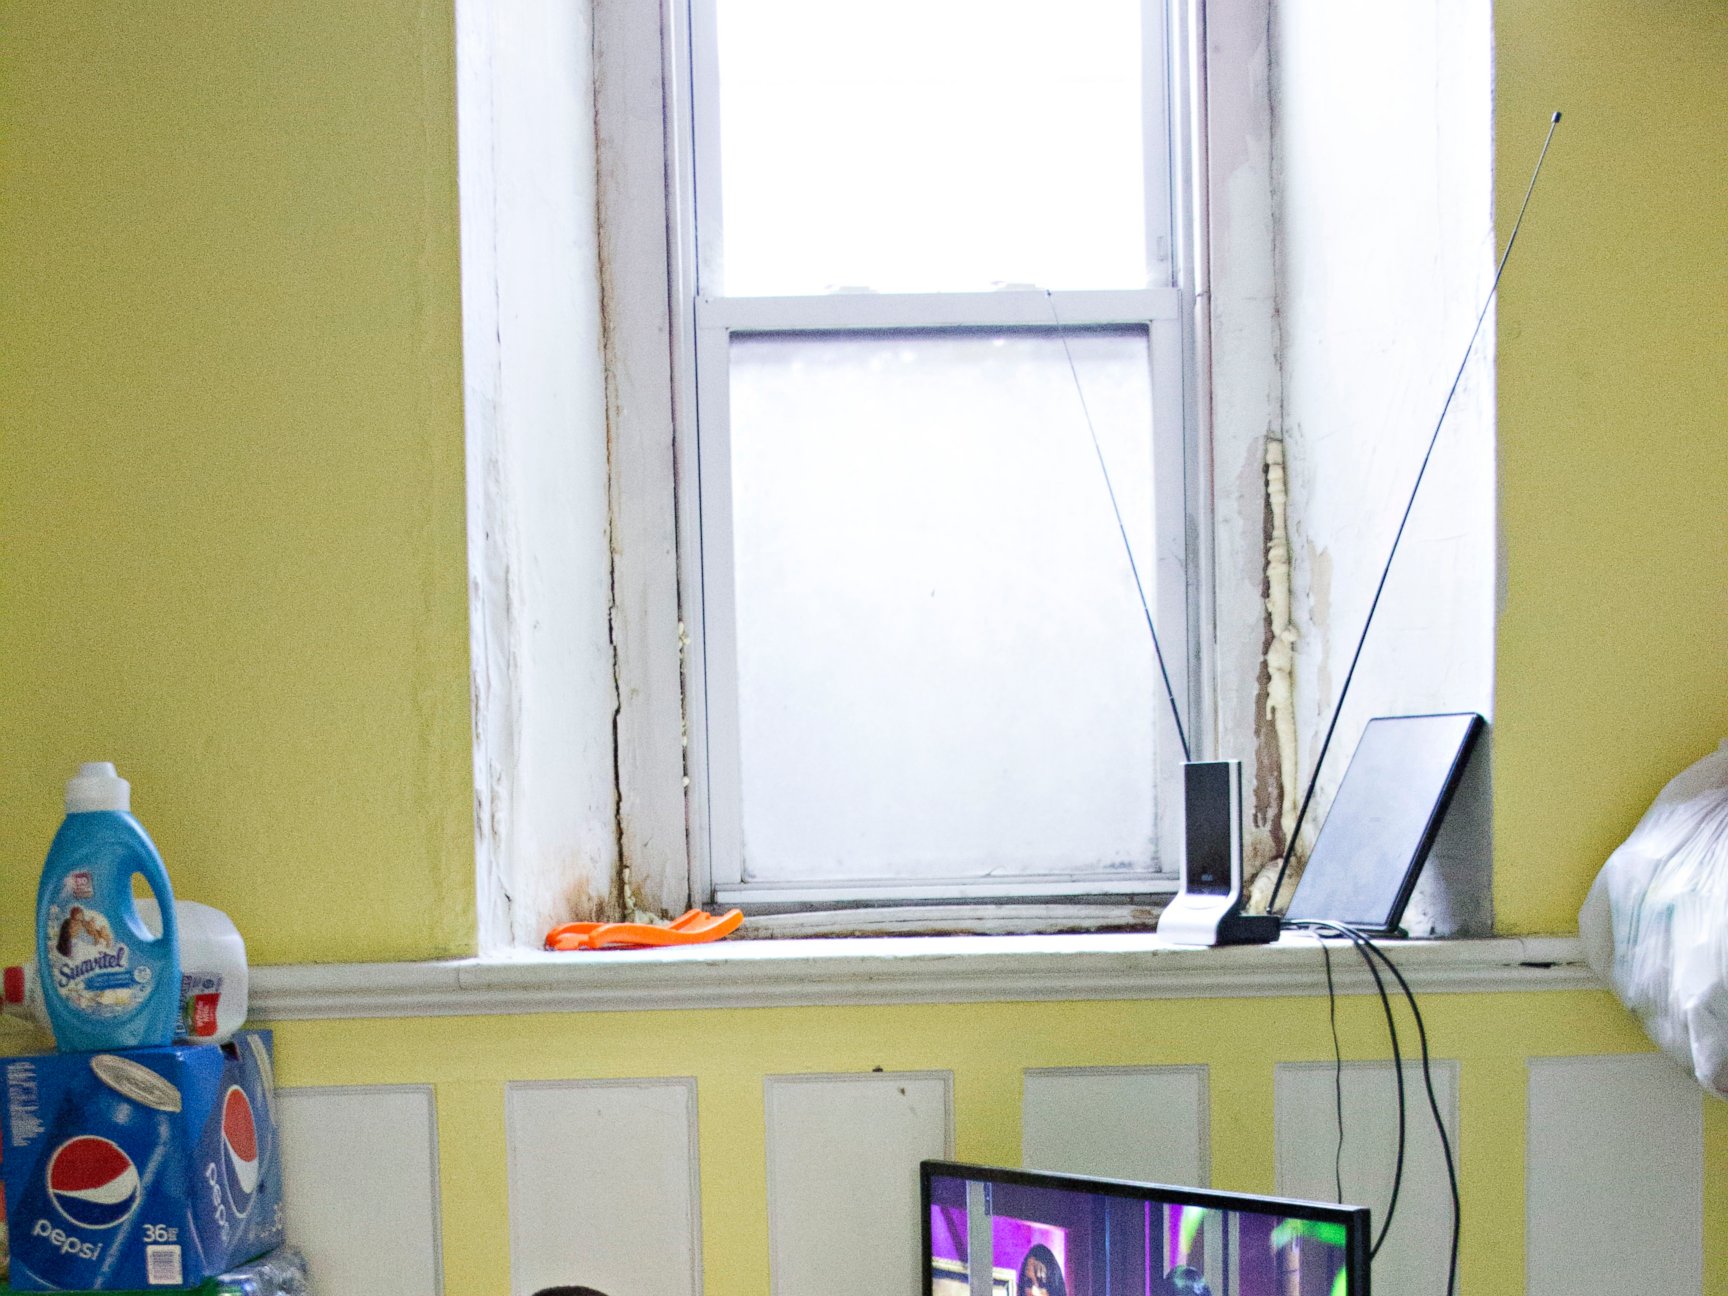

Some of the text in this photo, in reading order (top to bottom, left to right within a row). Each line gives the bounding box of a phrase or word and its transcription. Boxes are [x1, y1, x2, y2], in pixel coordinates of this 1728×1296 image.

[58, 945, 126, 988] Suavitel
[32, 1216, 103, 1262] pepsi
[142, 1223, 168, 1243] 36
